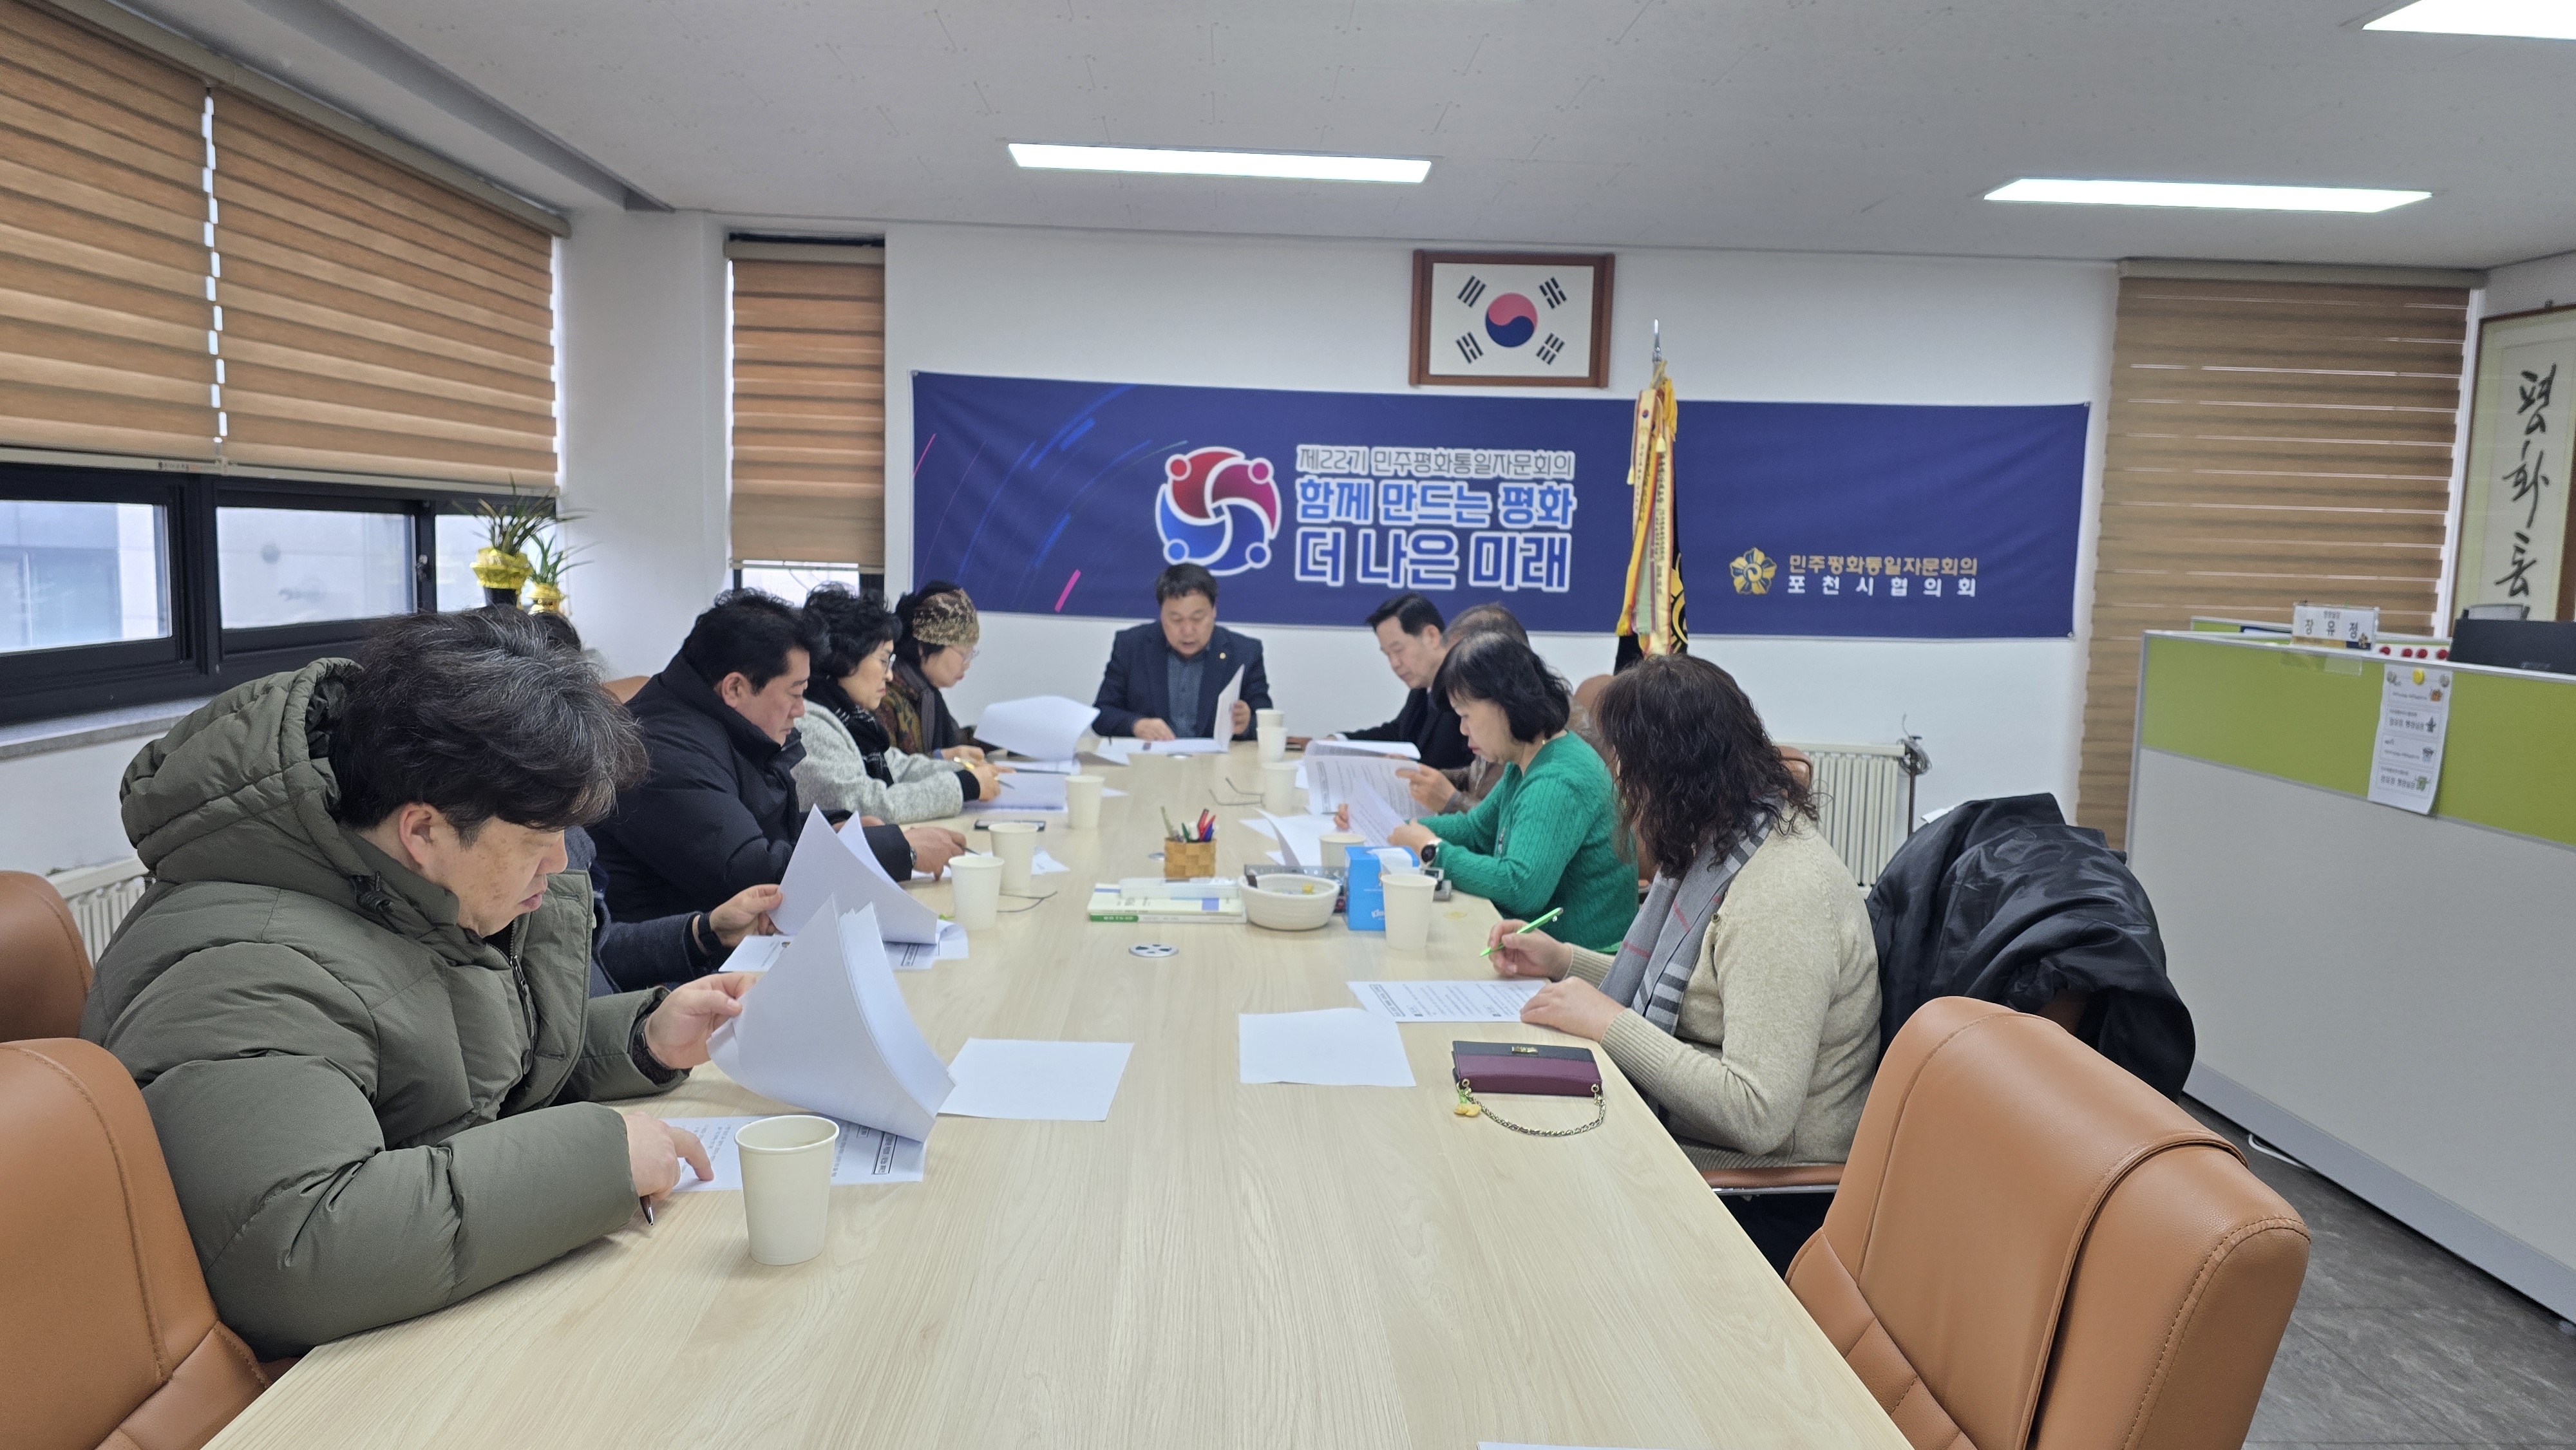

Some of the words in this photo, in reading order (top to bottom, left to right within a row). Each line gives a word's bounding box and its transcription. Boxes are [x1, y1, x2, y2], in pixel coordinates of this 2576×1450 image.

[1299, 447, 1367, 472] 제22기
[1374, 450, 1573, 476] 민주평화통일자문회의
[1299, 478, 1370, 521] 함께
[1382, 484, 1489, 524] 만드는
[1501, 485, 1573, 526] 평화
[1300, 531, 1342, 583] 더
[1361, 532, 1456, 587] 나은
[1473, 534, 1569, 588] 미래
[1788, 554, 1978, 576] 민주평화통일자문회의
